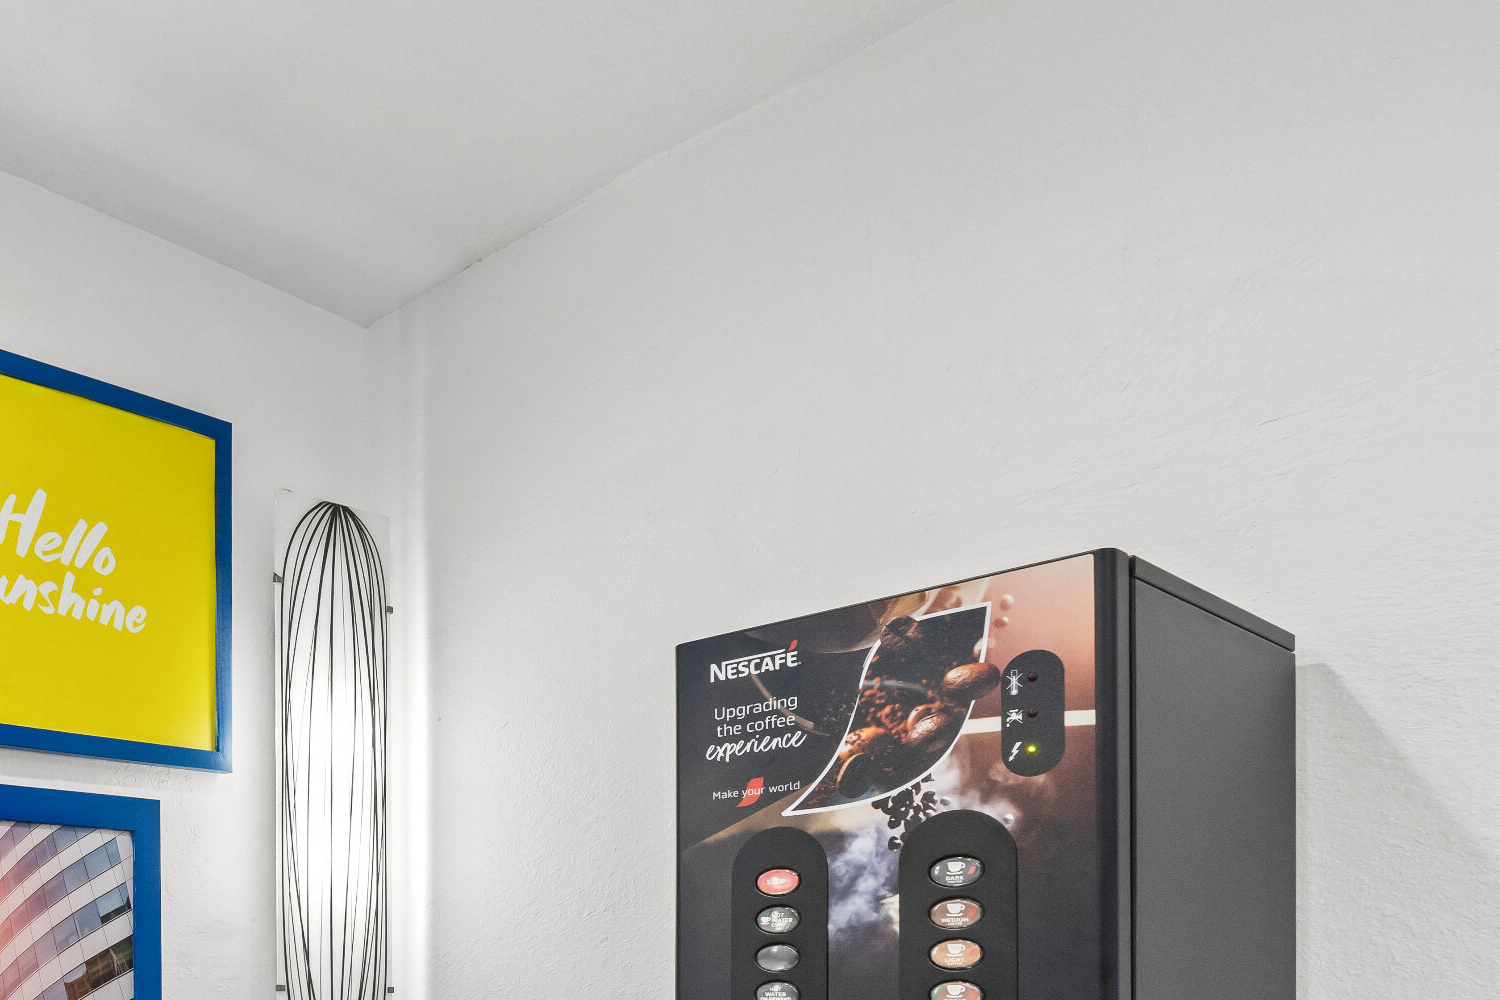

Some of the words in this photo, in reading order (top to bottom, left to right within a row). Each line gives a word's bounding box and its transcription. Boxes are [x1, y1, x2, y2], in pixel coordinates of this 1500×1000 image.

[710, 640, 798, 683] NESCAFÉ
[714, 696, 798, 721] Upgrading
[717, 724, 742, 738] the
[747, 715, 795, 733] coffee
[706, 731, 807, 762] experience
[712, 789, 739, 800] Make
[742, 786, 765, 799] your
[768, 780, 801, 793] world
